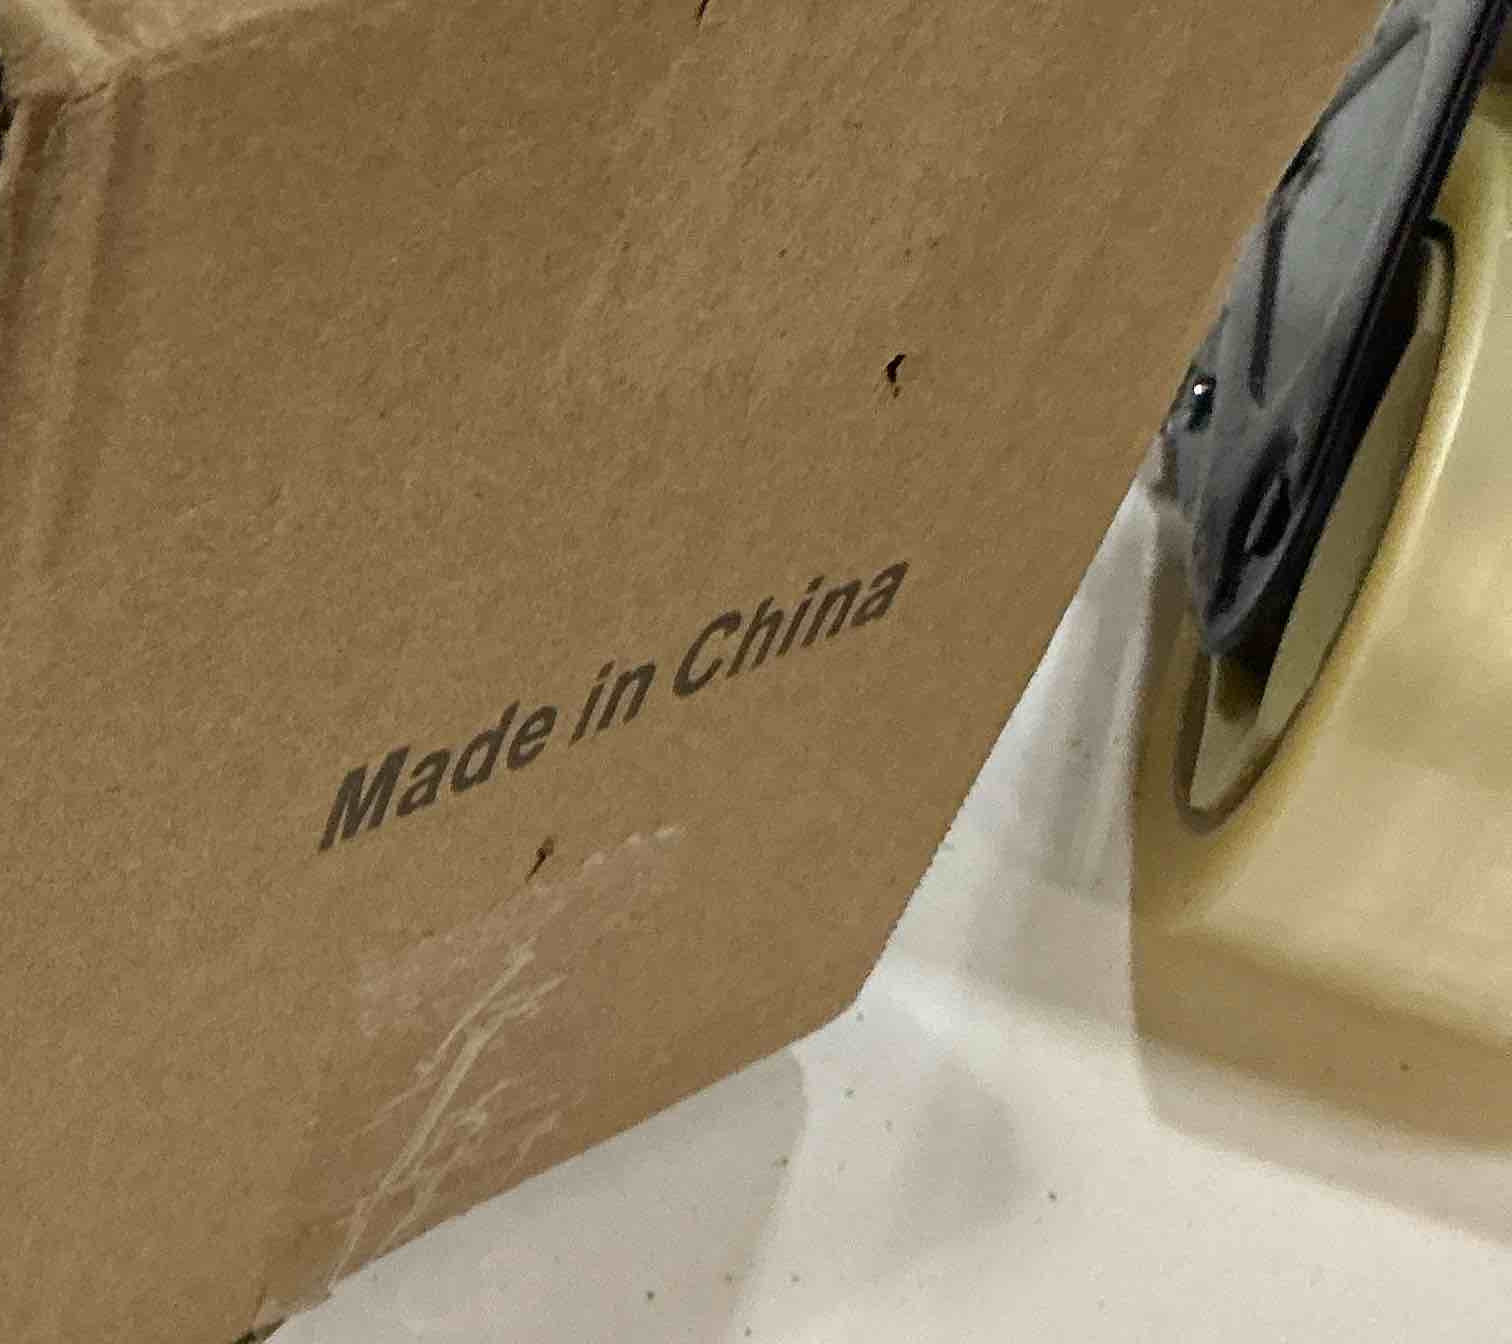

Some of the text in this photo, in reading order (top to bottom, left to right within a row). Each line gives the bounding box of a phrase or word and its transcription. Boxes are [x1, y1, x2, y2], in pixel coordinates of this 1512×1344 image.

[318, 560, 910, 852] Made in China
